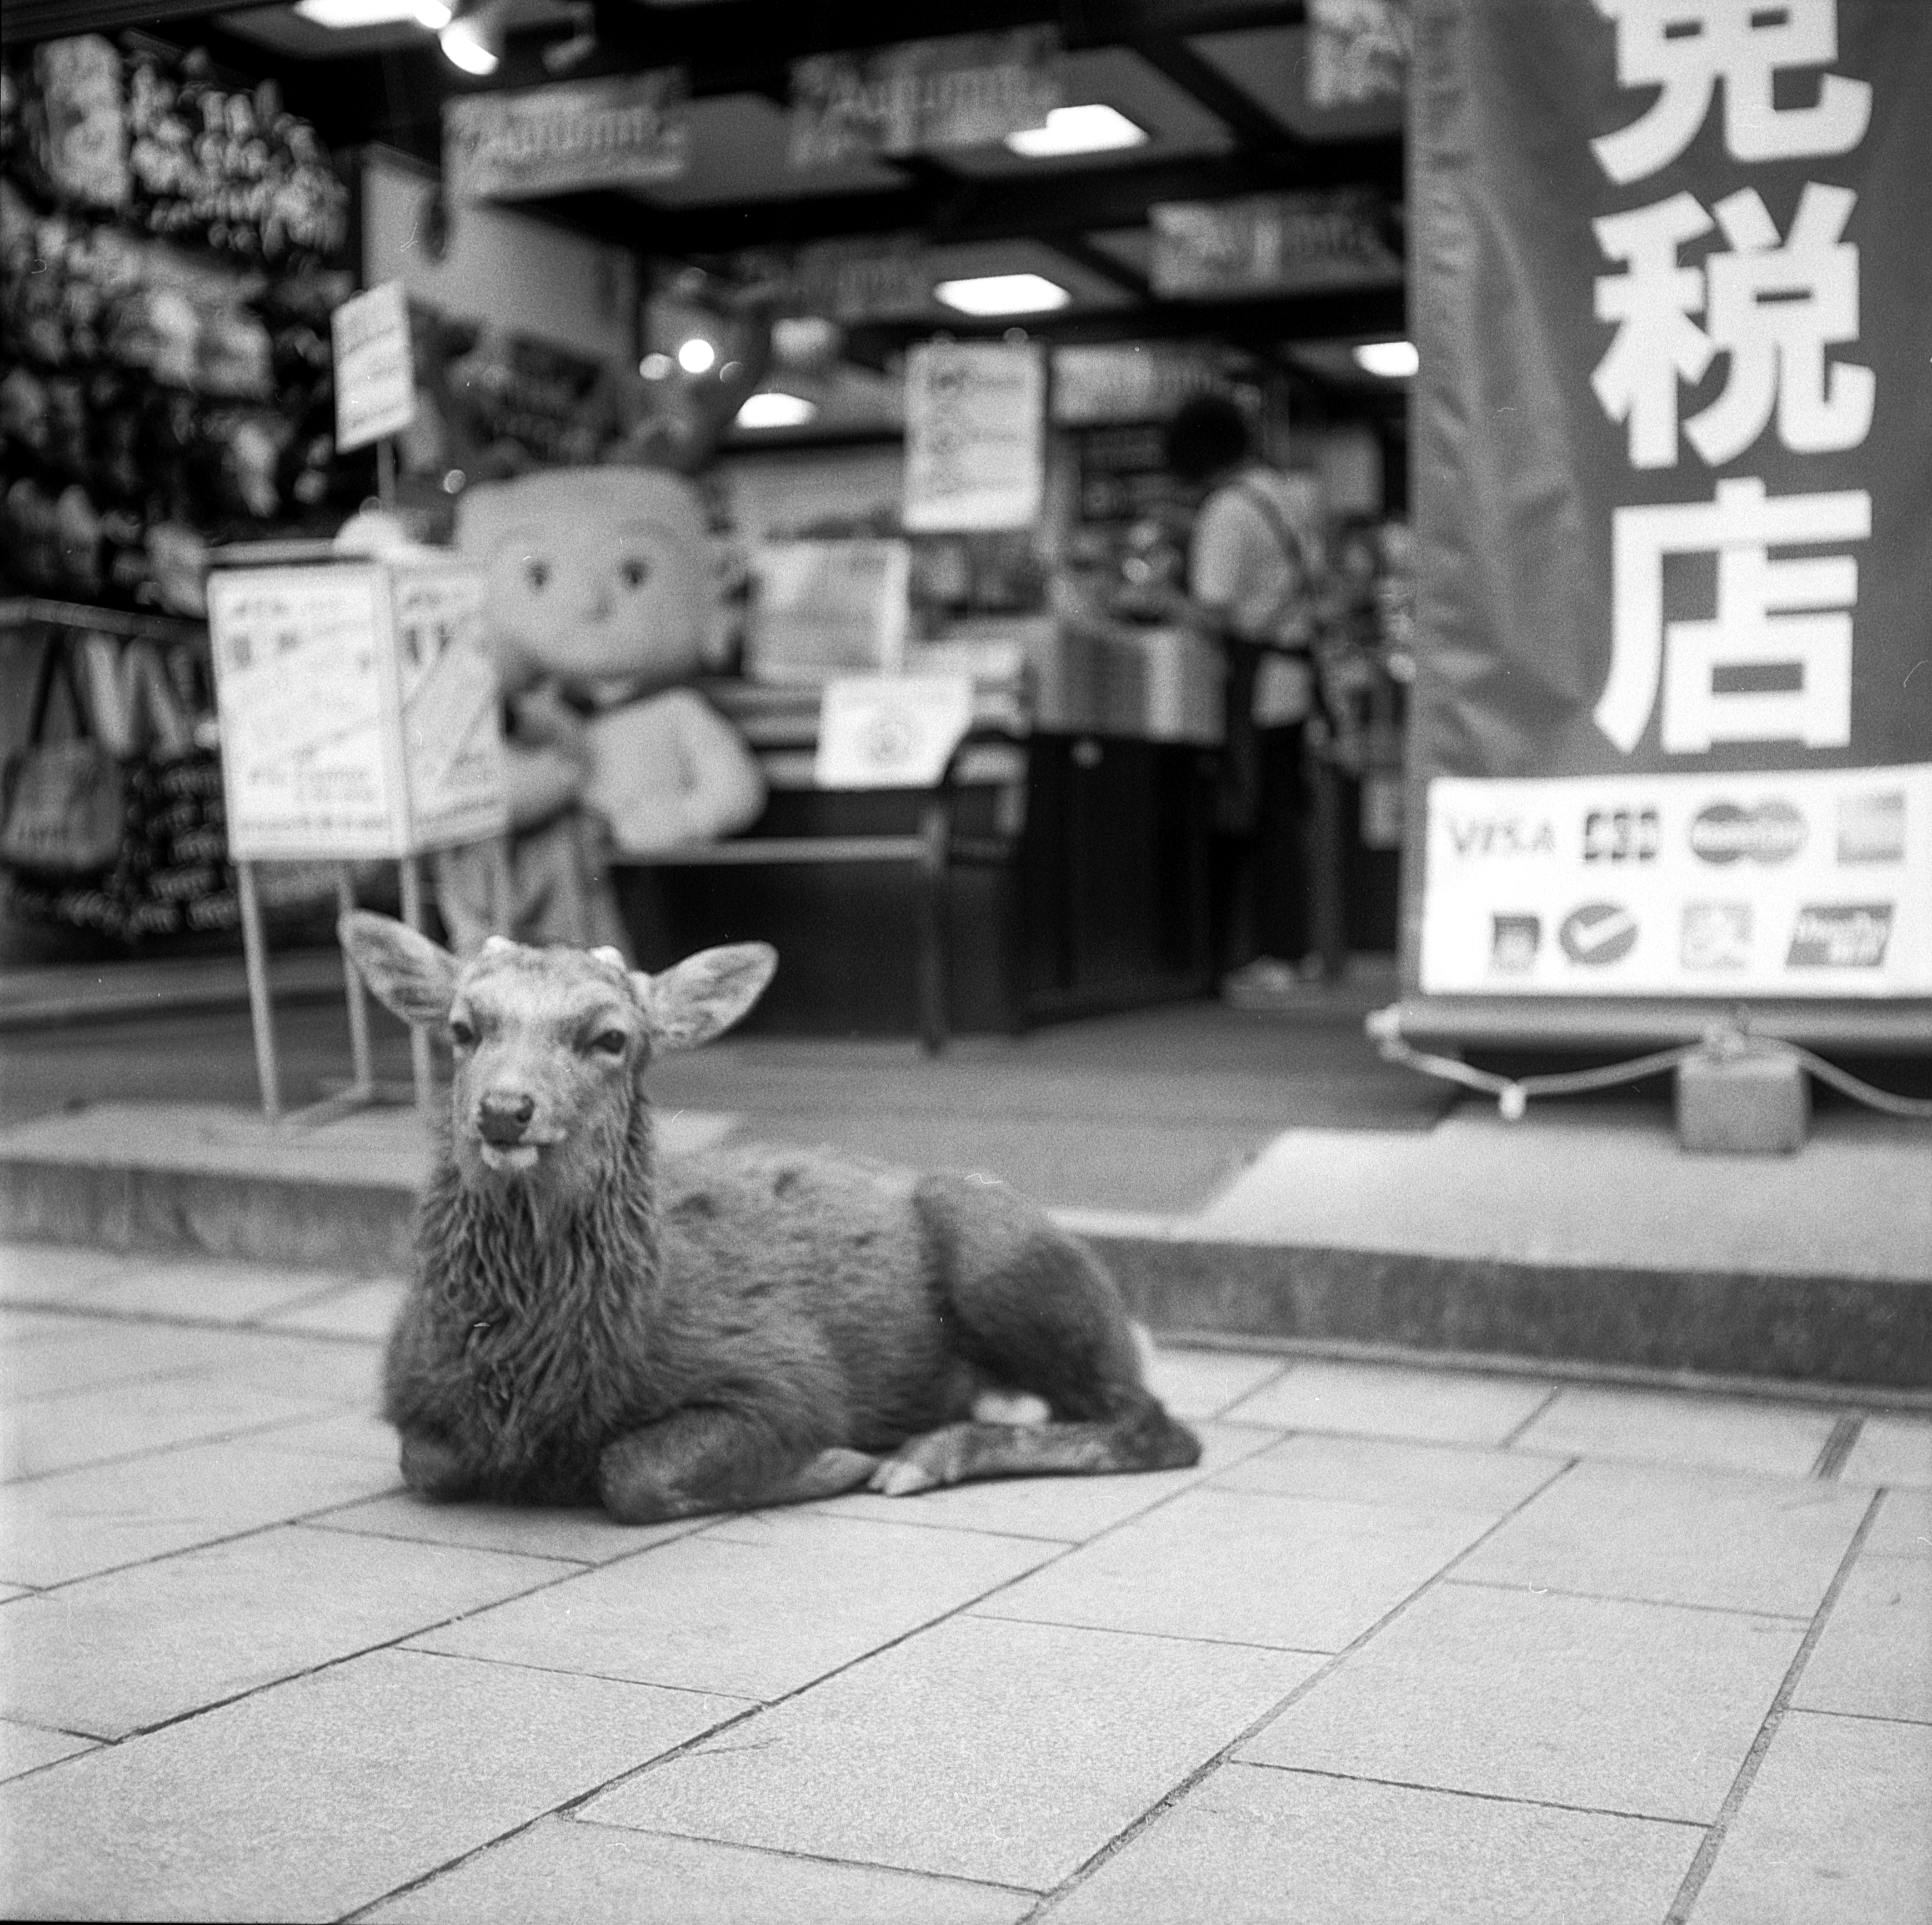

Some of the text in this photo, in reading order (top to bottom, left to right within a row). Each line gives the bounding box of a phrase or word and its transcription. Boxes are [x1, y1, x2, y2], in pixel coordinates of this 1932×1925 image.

[1590, 0, 1876, 753] 免税店
[1446, 815, 1555, 855] VISA
